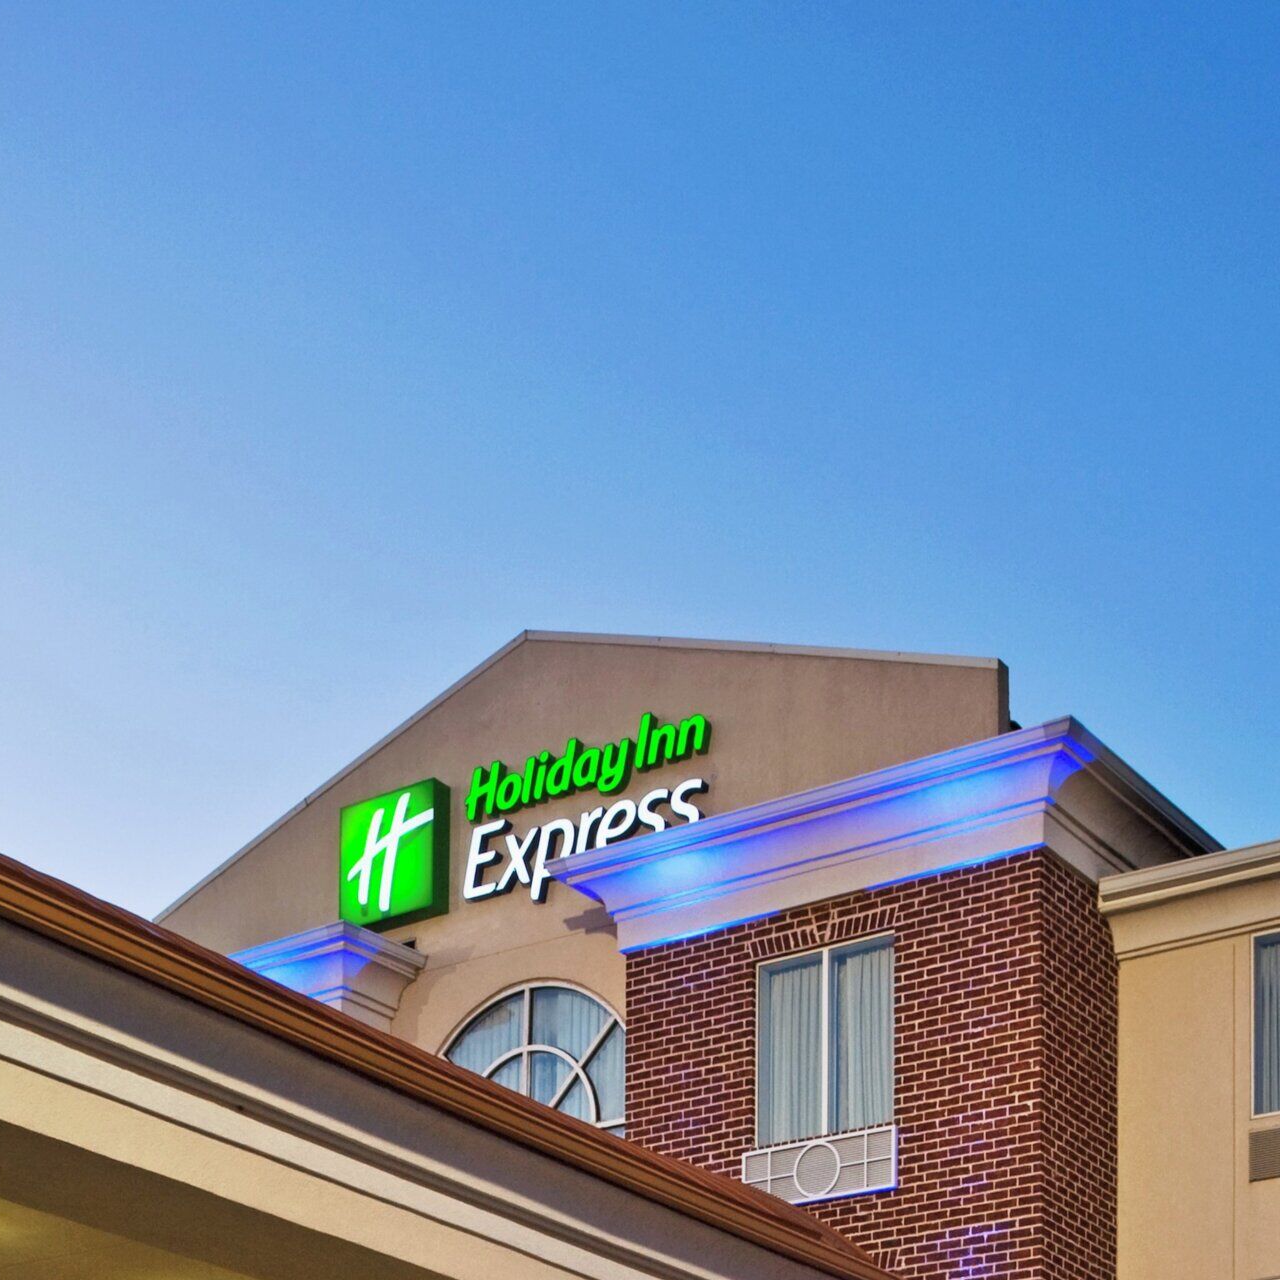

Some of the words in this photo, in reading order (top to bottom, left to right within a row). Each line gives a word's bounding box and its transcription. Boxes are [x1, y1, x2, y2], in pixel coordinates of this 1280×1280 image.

[465, 736, 633, 821] Holiday
[634, 712, 711, 770] Inn
[462, 778, 709, 903] Express
